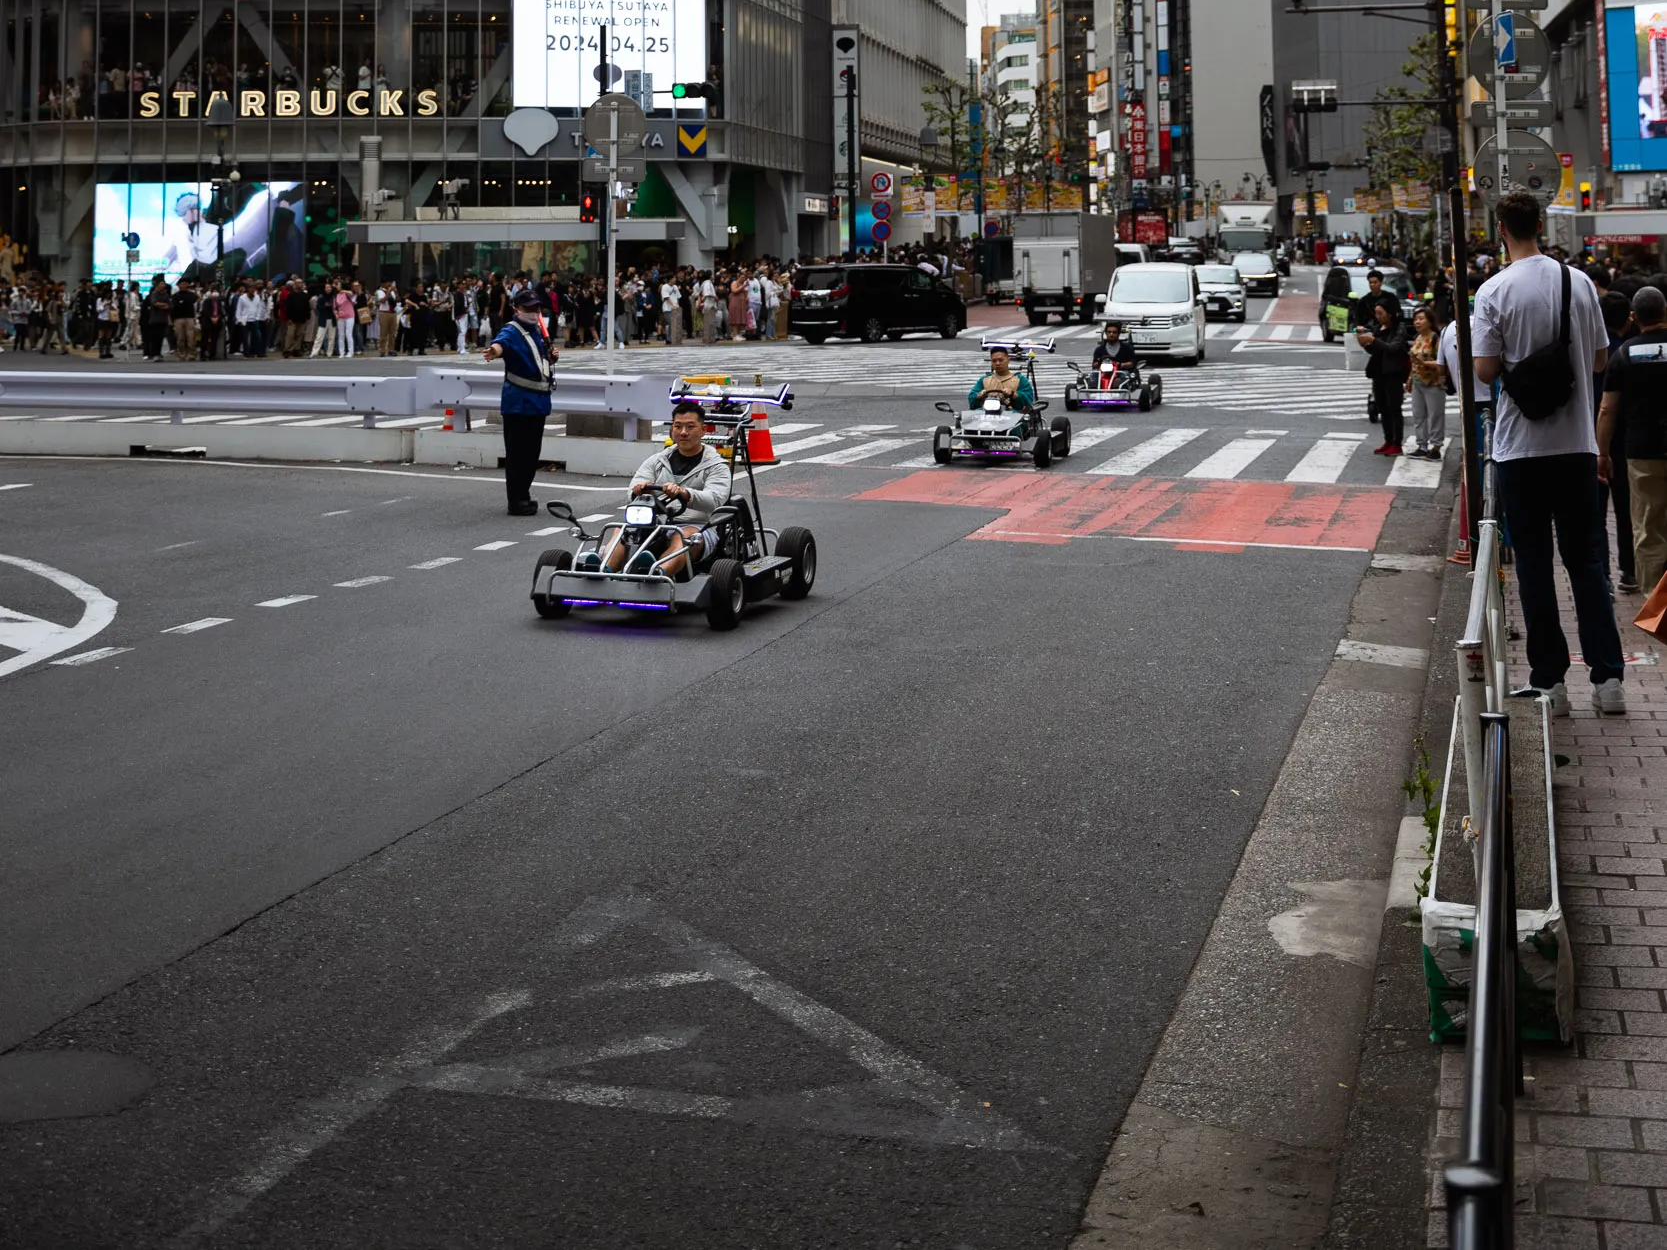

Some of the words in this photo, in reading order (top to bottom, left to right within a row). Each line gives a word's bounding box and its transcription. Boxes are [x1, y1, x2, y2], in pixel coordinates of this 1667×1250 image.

[546, 0, 604, 10] SHIBUYA
[611, 1, 668, 11] SUTAYA
[554, 16, 619, 26] RENEWAL
[623, 18, 660, 27] OPEN
[546, 35, 669, 53] 202404.25
